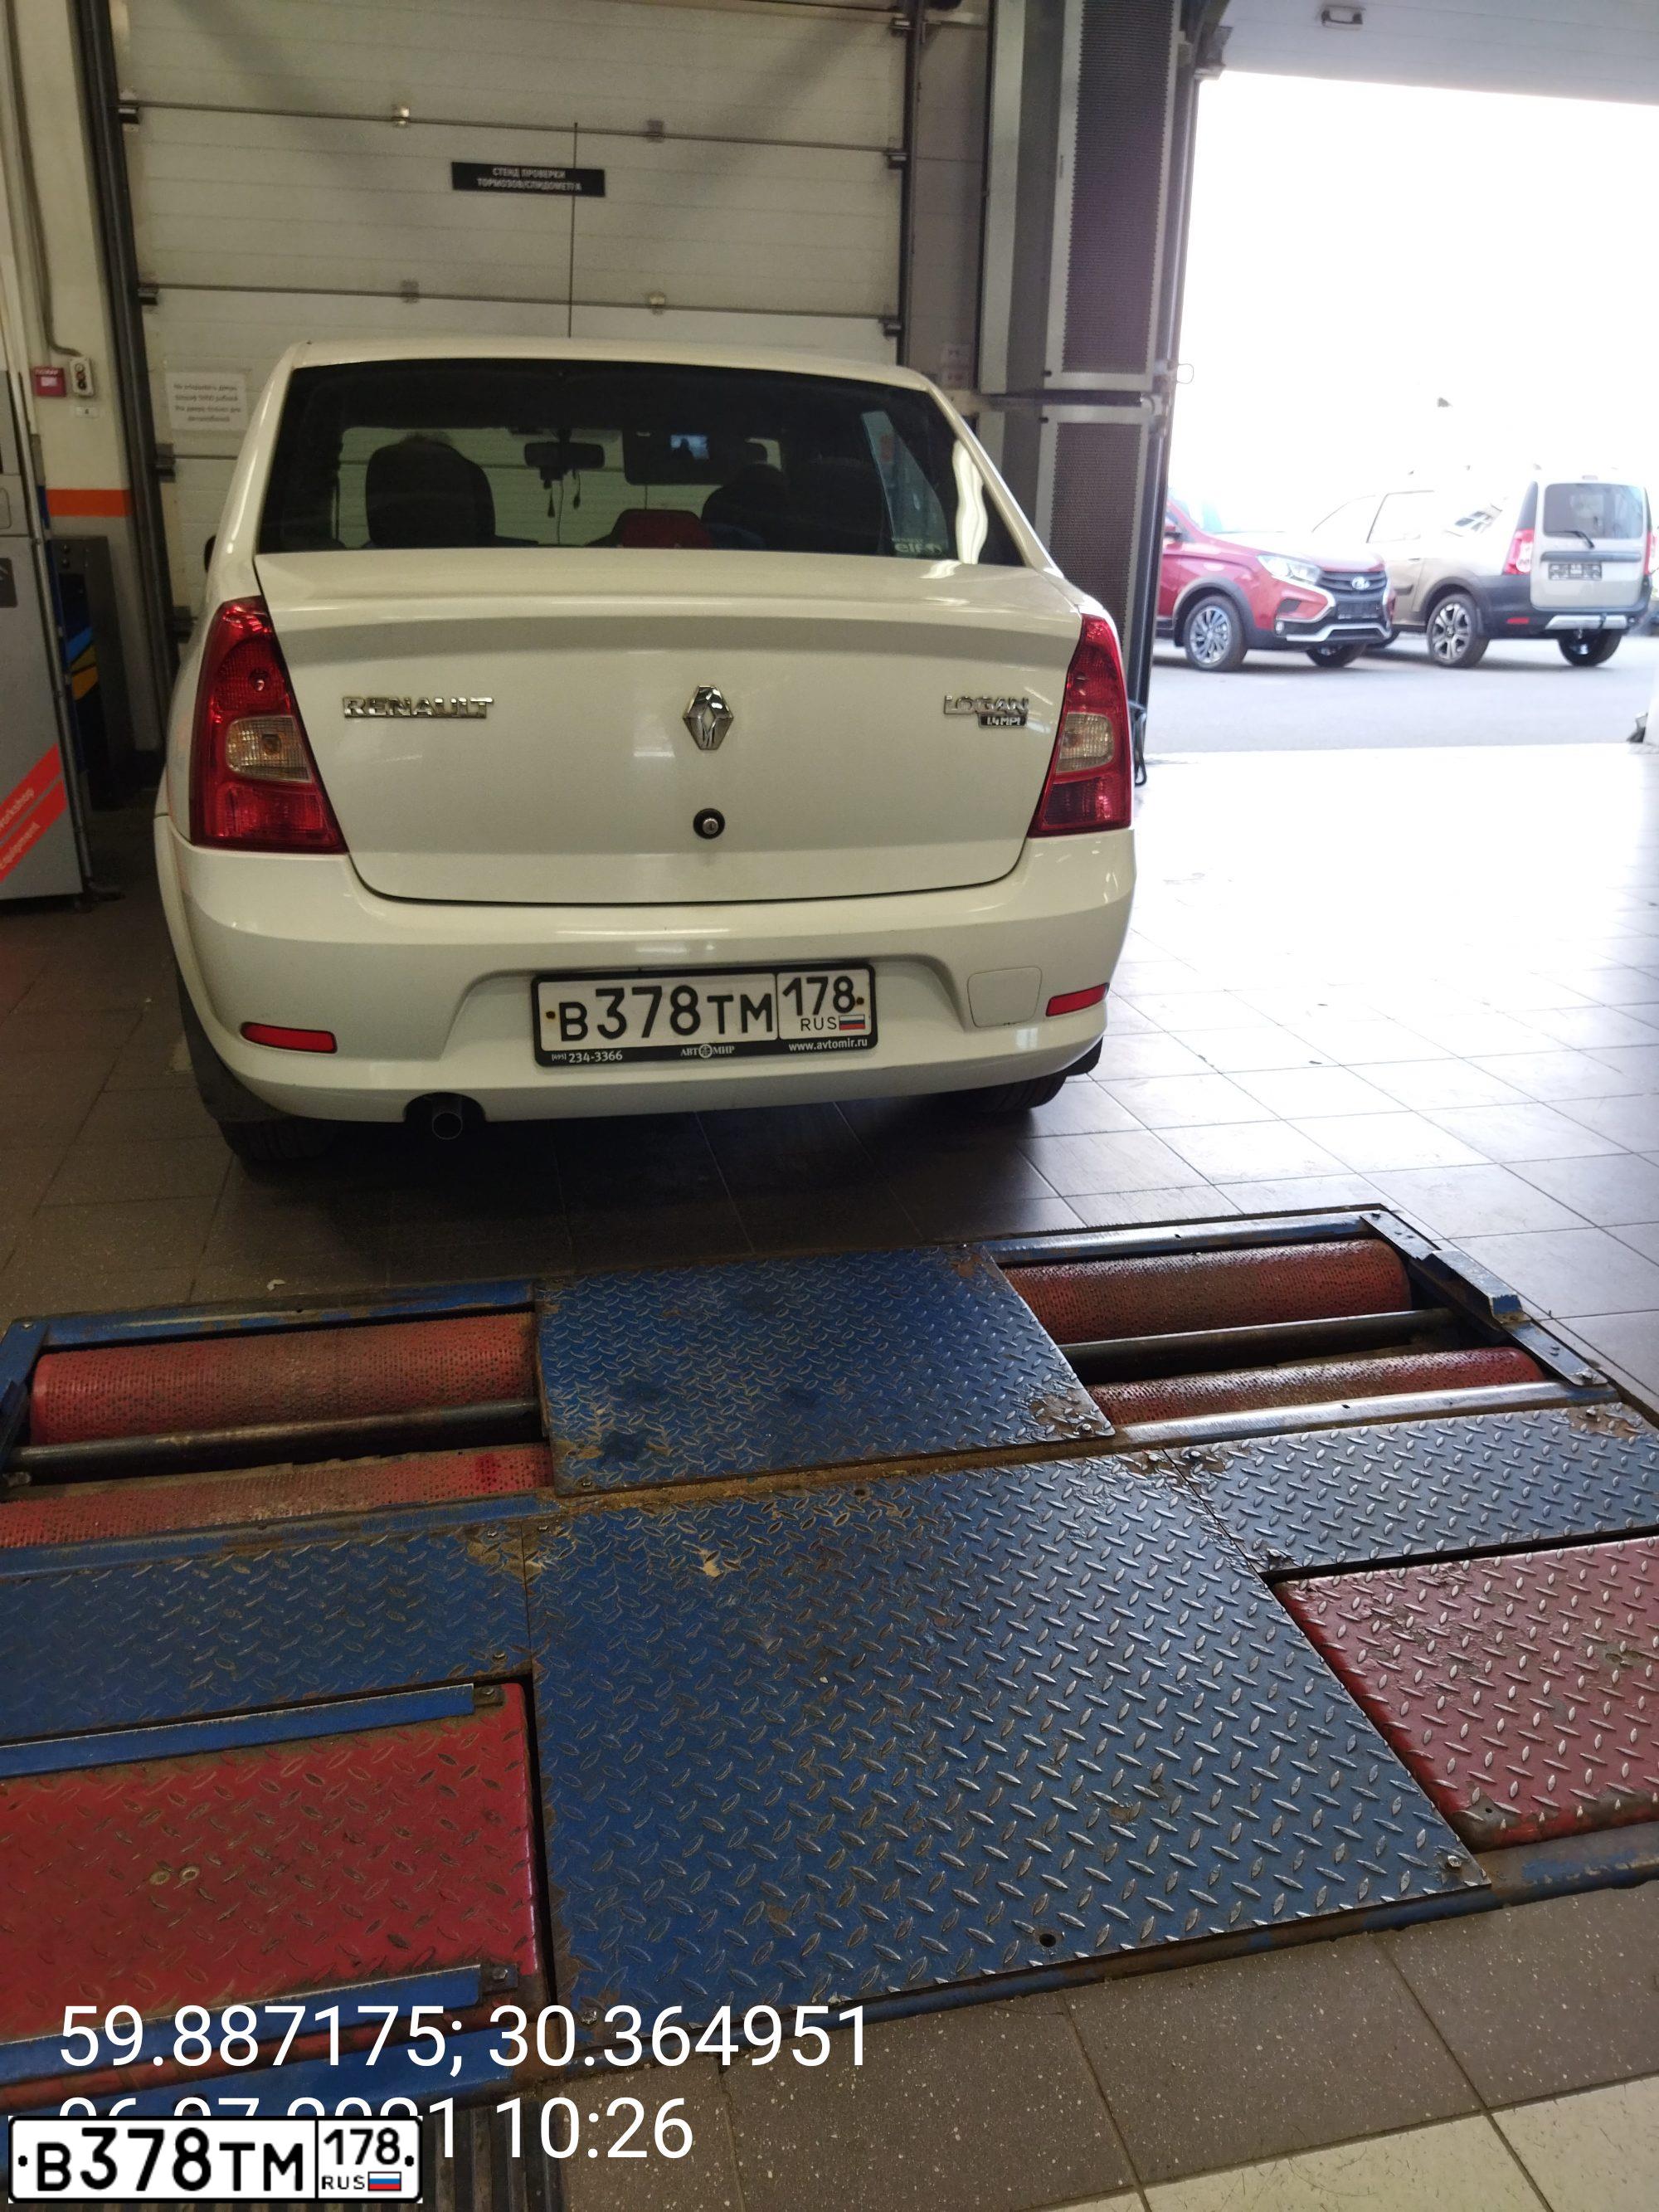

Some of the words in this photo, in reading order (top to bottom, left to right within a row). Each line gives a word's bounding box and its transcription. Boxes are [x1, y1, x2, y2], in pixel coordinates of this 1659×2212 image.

[343, 696, 495, 719] RENAULT
[943, 695, 1029, 715] LOGAN
[781, 975, 855, 1016] 178
[800, 1016, 838, 1031] RUS
[788, 1038, 868, 1052] www.avtomir.ru
[568, 1050, 624, 1064] 234-3366
